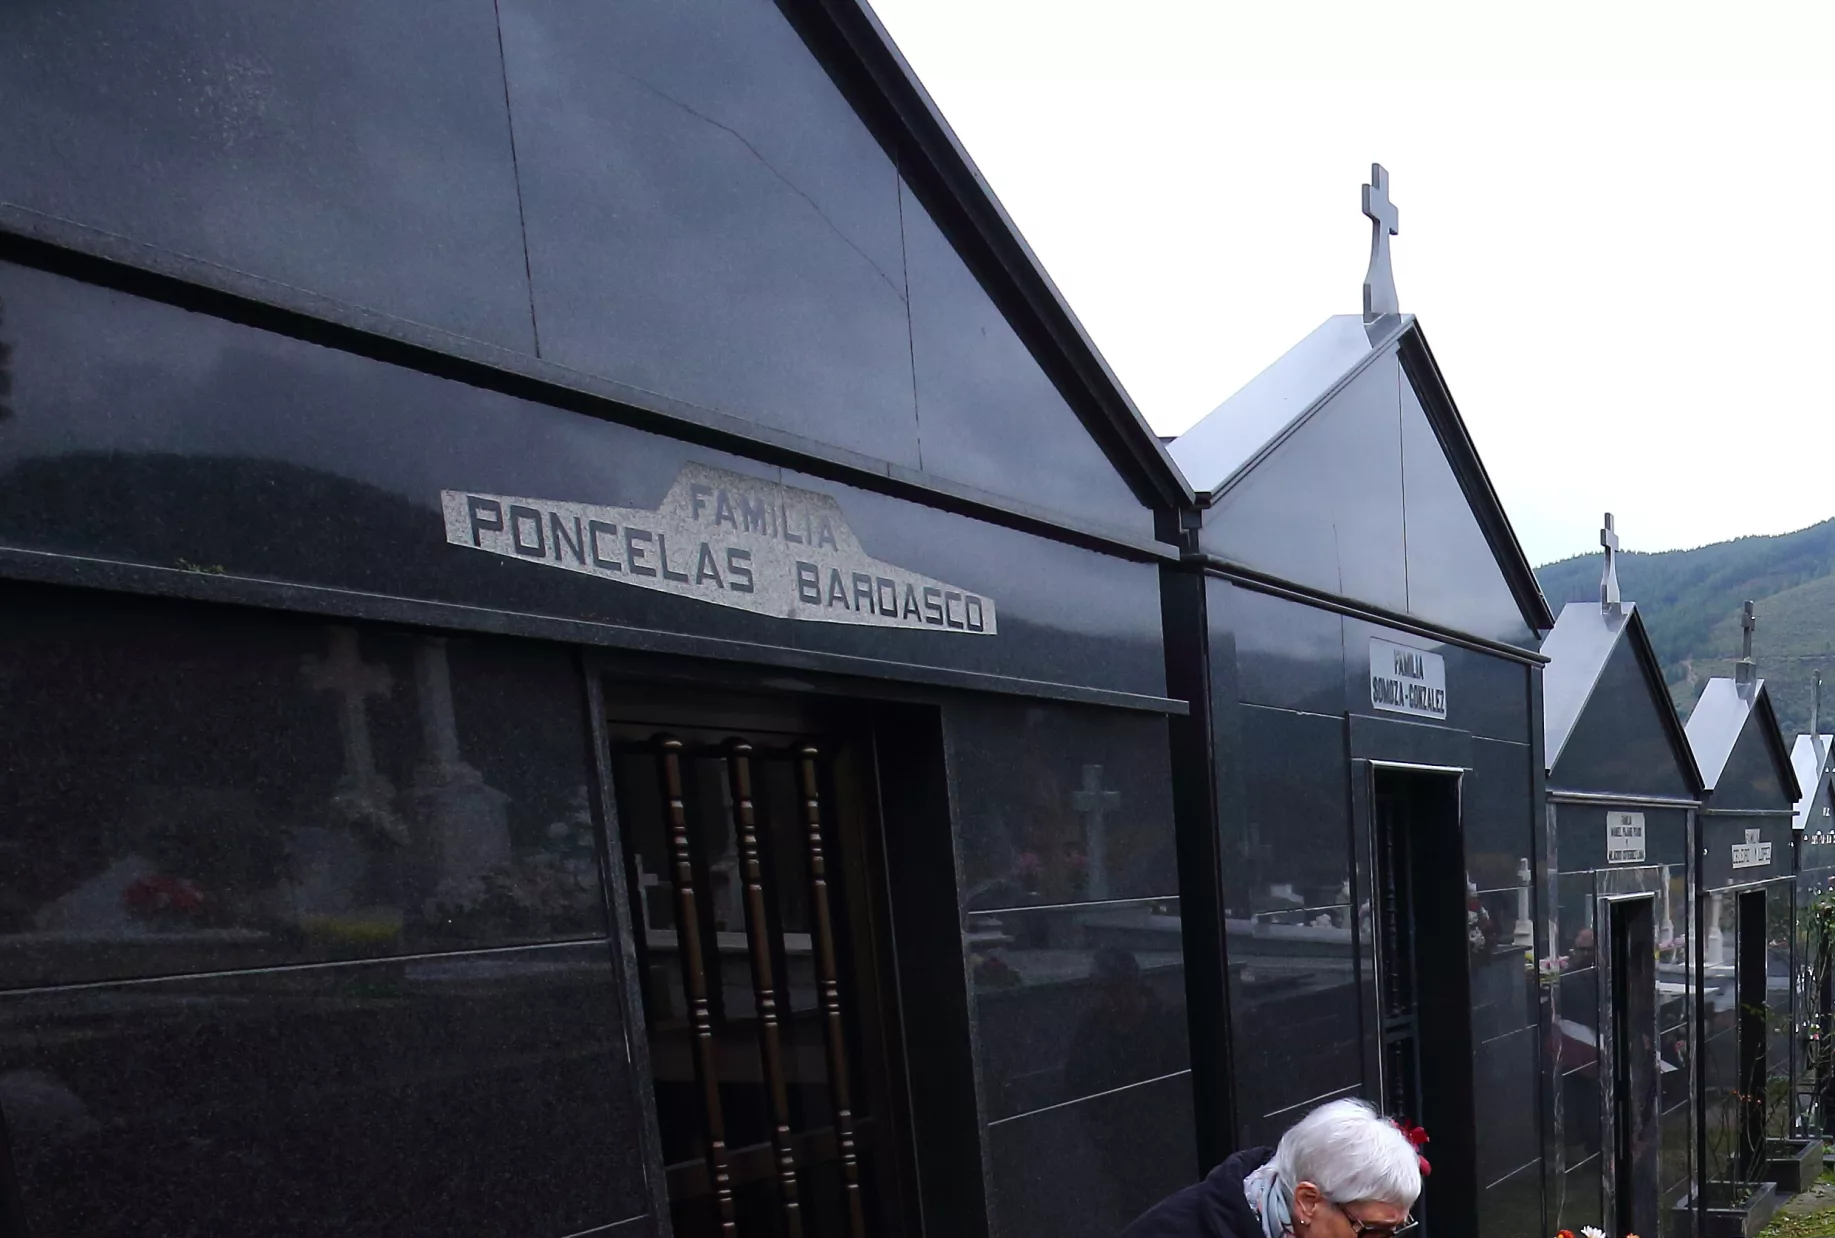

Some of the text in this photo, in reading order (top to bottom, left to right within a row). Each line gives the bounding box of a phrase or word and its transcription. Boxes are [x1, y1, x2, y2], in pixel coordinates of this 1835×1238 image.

[690, 482, 839, 552] FAMILIA
[466, 494, 984, 632] PONCELAS BARDASCO
[1393, 648, 1424, 680] FAMILIA
